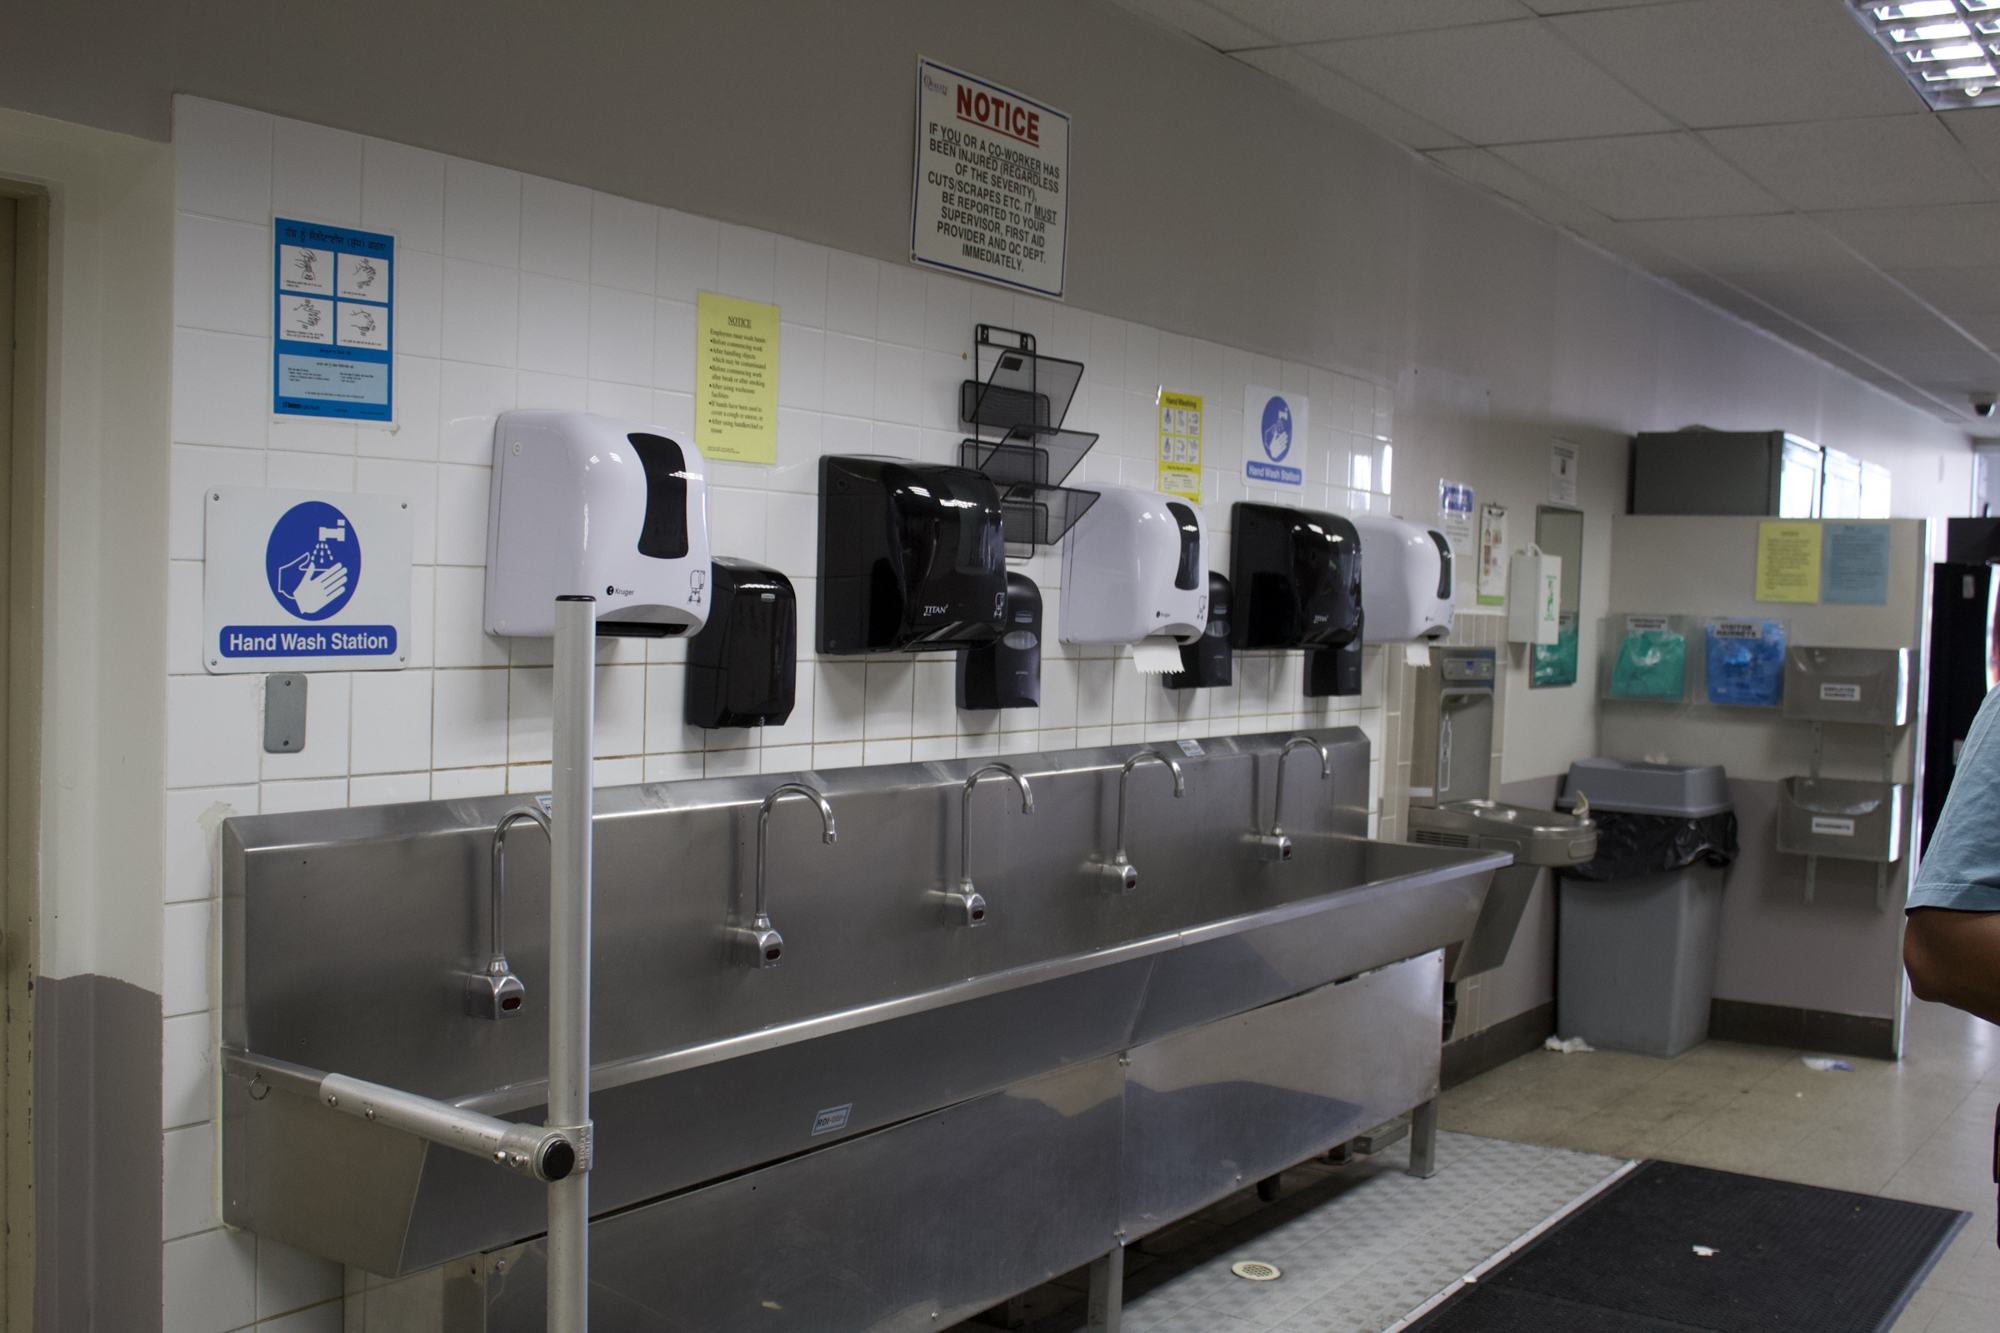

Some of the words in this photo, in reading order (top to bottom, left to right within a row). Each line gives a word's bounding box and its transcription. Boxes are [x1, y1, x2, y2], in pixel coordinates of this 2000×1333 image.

[957, 84, 1040, 142] NOTICE
[929, 122, 938, 135] IF
[942, 126, 961, 144] YOU
[963, 134, 977, 149] OR
[979, 139, 987, 152] A
[988, 142, 1041, 171] CO-WORKER
[1043, 162, 1060, 179] HAS
[929, 138, 956, 158] BEEN
[958, 147, 998, 172] INJURED
[1000, 159, 1060, 194] (REGARDLESS
[928, 171, 1000, 204] CUTS/SCRAPES
[1003, 196, 1023, 212] ETC.
[1025, 202, 1033, 214] IT
[1034, 204, 1057, 223] MUST
[955, 162, 969, 177] OF
[971, 166, 989, 183] THE
[991, 173, 1037, 202] SEVERITY).
[941, 206, 1004, 237] SUPERVISOR,
[1005, 224, 1029, 242] FIRST
[1031, 234, 1045, 248] AID
[942, 191, 955, 206] BE
[957, 195, 1007, 221] REPORTED
[1009, 210, 1020, 225] TO
[1022, 215, 1046, 234] YOUR
[936, 221, 986, 247] PROVIDER
[988, 235, 1007, 251] AND
[1008, 243, 1021, 256] QC
[1023, 246, 1047, 264] DEPT.
[962, 243, 1025, 273] IMMEDIATELY.
[728, 315, 752, 329] NOTICE
[1248, 464, 1265, 478] Hand
[1265, 467, 1281, 481] Wash
[1281, 469, 1300, 483] Station
[615, 588, 634, 597] Kruger
[924, 606, 945, 614] TITAN
[230, 633, 276, 651] Hand
[280, 633, 327, 651] Wash
[331, 632, 388, 650] Station
